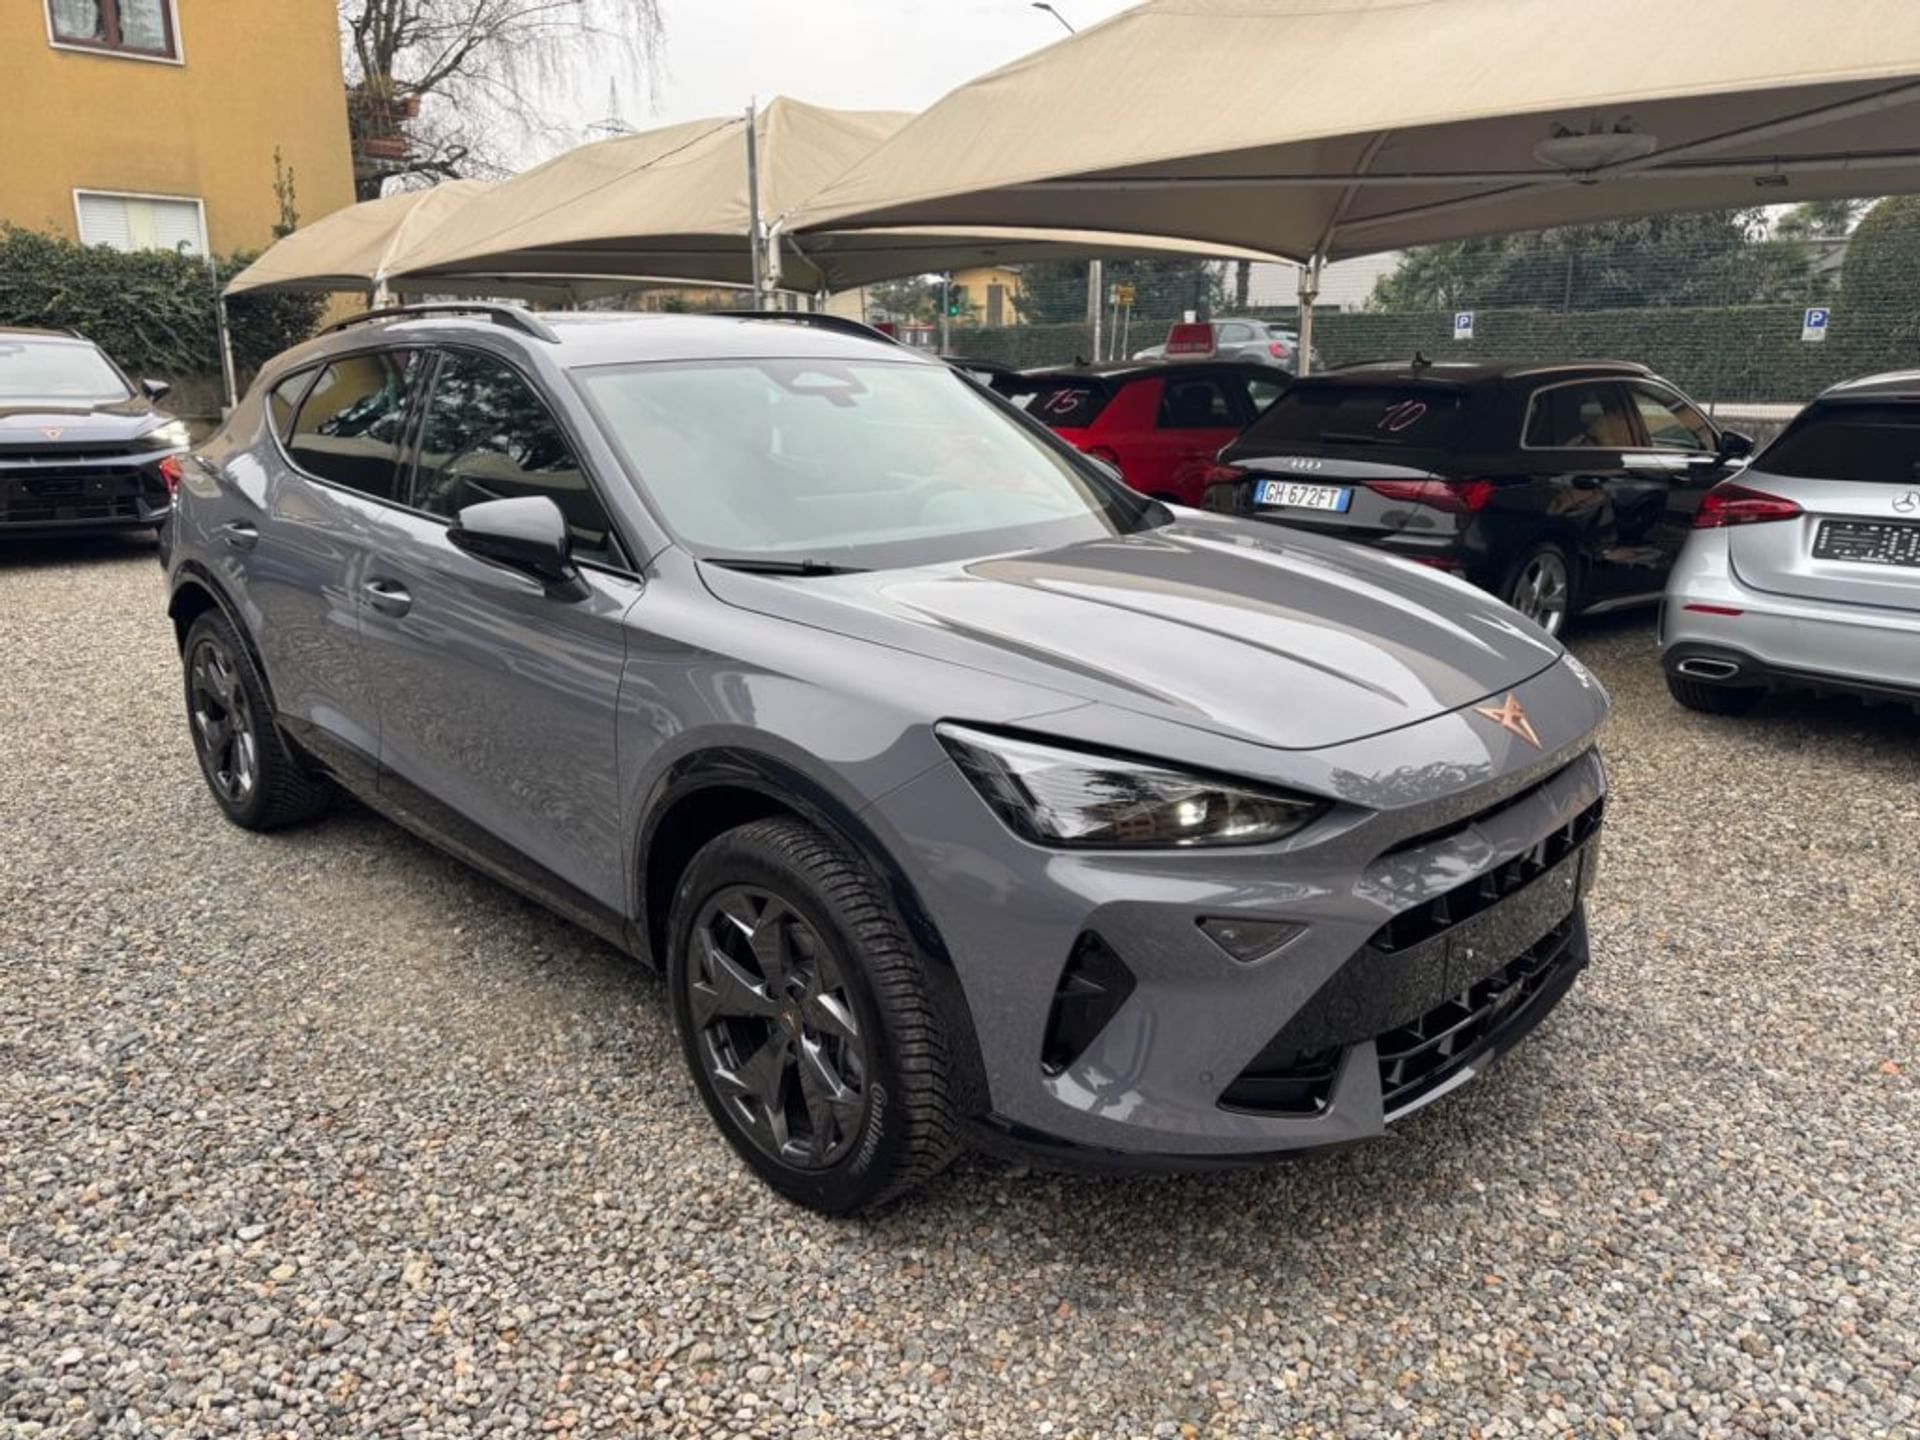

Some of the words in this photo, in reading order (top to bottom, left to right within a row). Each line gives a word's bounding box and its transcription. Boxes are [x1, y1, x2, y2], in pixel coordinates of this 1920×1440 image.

[1459, 317, 1469, 328] P
[1810, 312, 1823, 326] P
[1265, 482, 1285, 502] GH
[1288, 485, 1338, 508] 672FT
